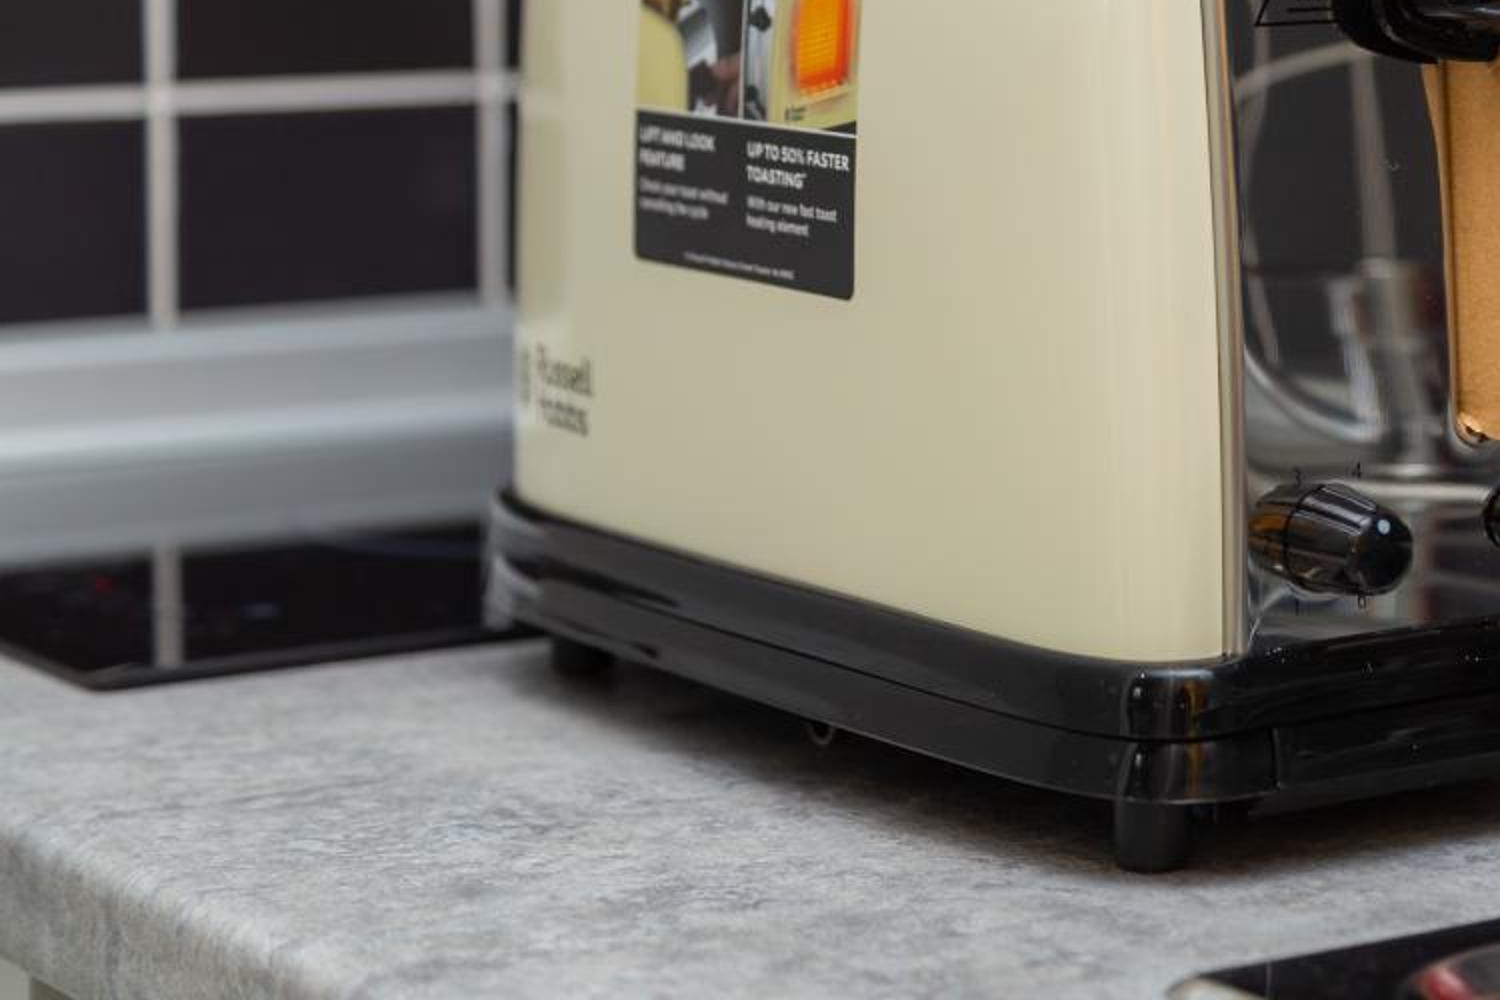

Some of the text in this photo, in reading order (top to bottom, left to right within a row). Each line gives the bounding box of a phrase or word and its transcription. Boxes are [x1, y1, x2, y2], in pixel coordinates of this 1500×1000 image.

[746, 140, 850, 173] UP TO 50% FASTER
